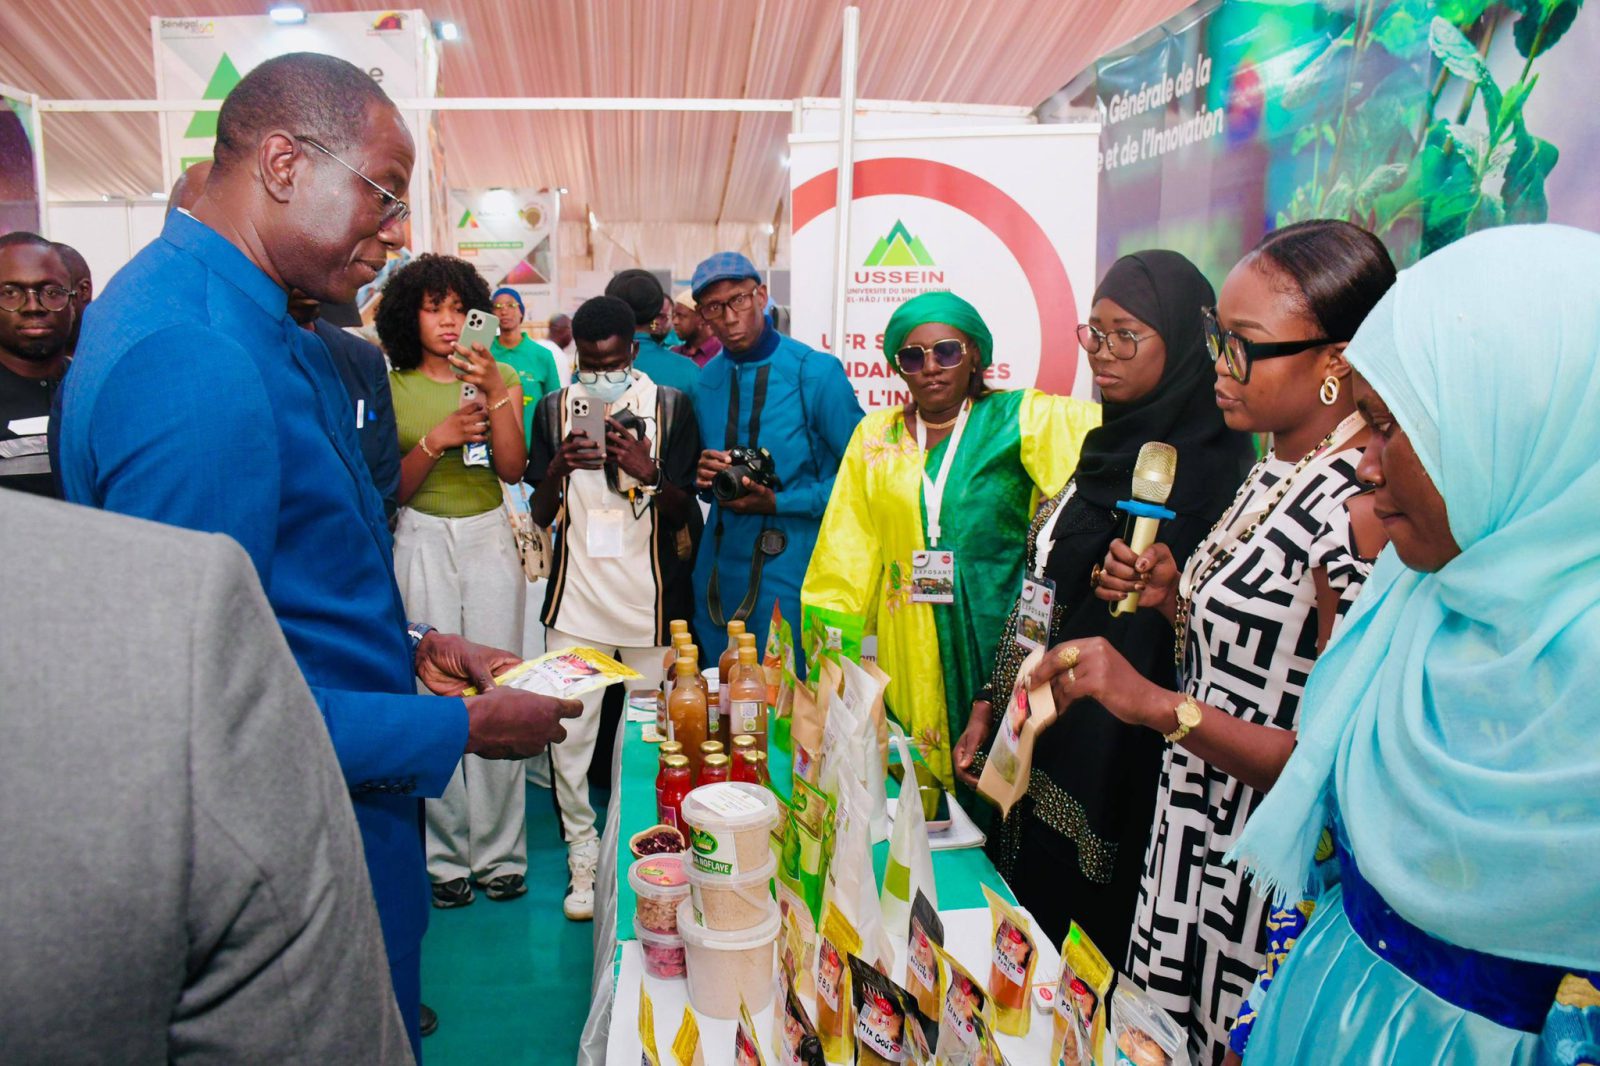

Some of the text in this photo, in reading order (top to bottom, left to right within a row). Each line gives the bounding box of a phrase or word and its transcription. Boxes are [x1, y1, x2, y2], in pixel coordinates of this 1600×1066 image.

[1109, 72, 1174, 124] Générale
[1175, 62, 1194, 97] de
[1196, 53, 1212, 88] la
[1105, 142, 1118, 170] et
[1120, 135, 1139, 167] de
[854, 271, 944, 284] USSEIN
[888, 287, 899, 295] DU
